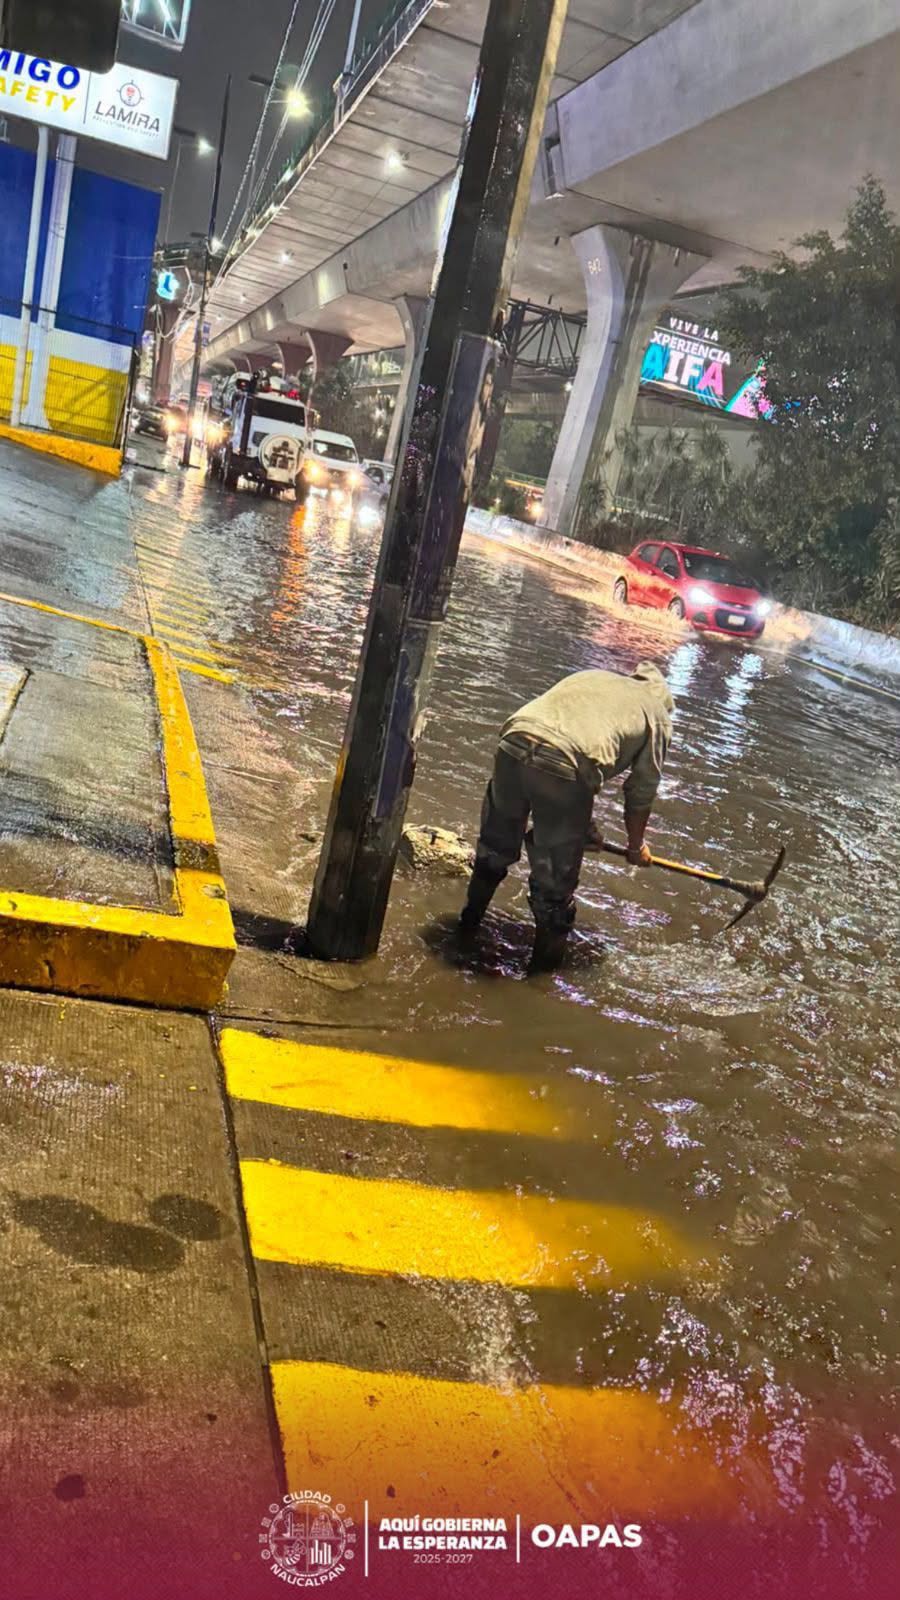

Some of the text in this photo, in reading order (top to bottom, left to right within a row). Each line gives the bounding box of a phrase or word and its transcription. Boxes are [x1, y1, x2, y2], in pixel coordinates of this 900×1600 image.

[95, 101, 160, 132] LAMIRA
[670, 317, 719, 341] VIVE LA
[650, 330, 731, 365] XPERIENCIA
[641, 341, 724, 396] AIFA
